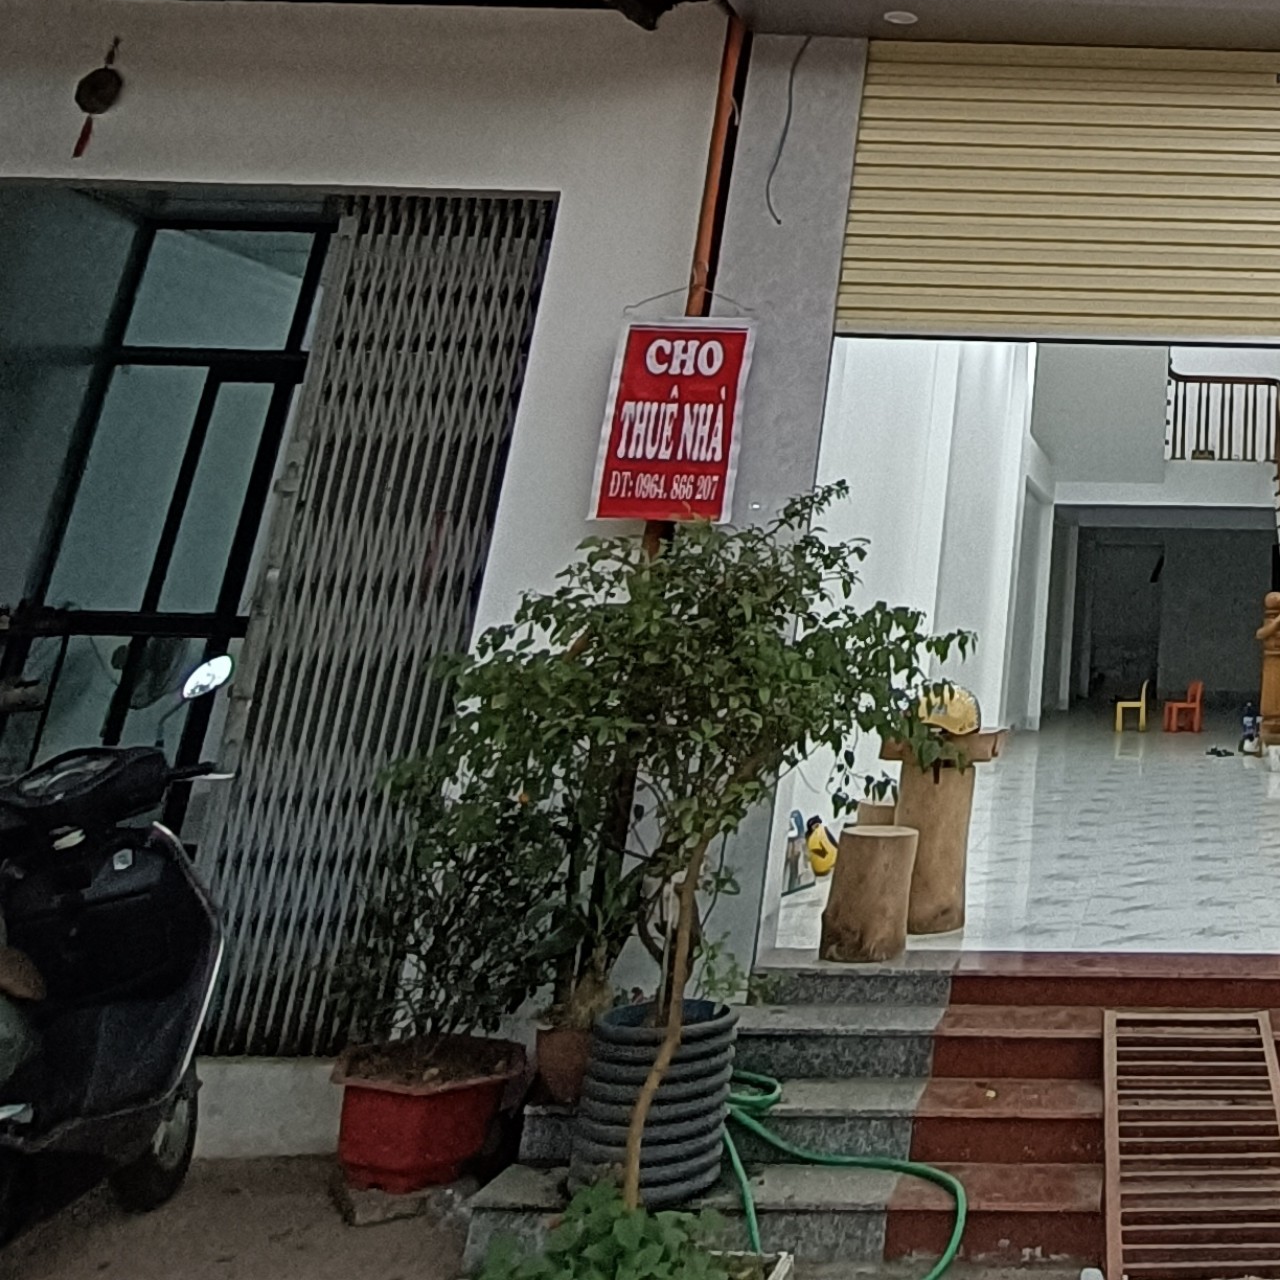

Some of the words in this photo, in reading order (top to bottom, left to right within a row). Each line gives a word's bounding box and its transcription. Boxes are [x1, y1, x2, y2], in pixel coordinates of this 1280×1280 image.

[646, 339, 724, 376] CHO
[616, 384, 680, 461] THUÊ
[677, 385, 727, 462] NHÀ
[608, 470, 634, 499] ĐT:
[670, 474, 694, 501] 866
[694, 475, 720, 501] 207
